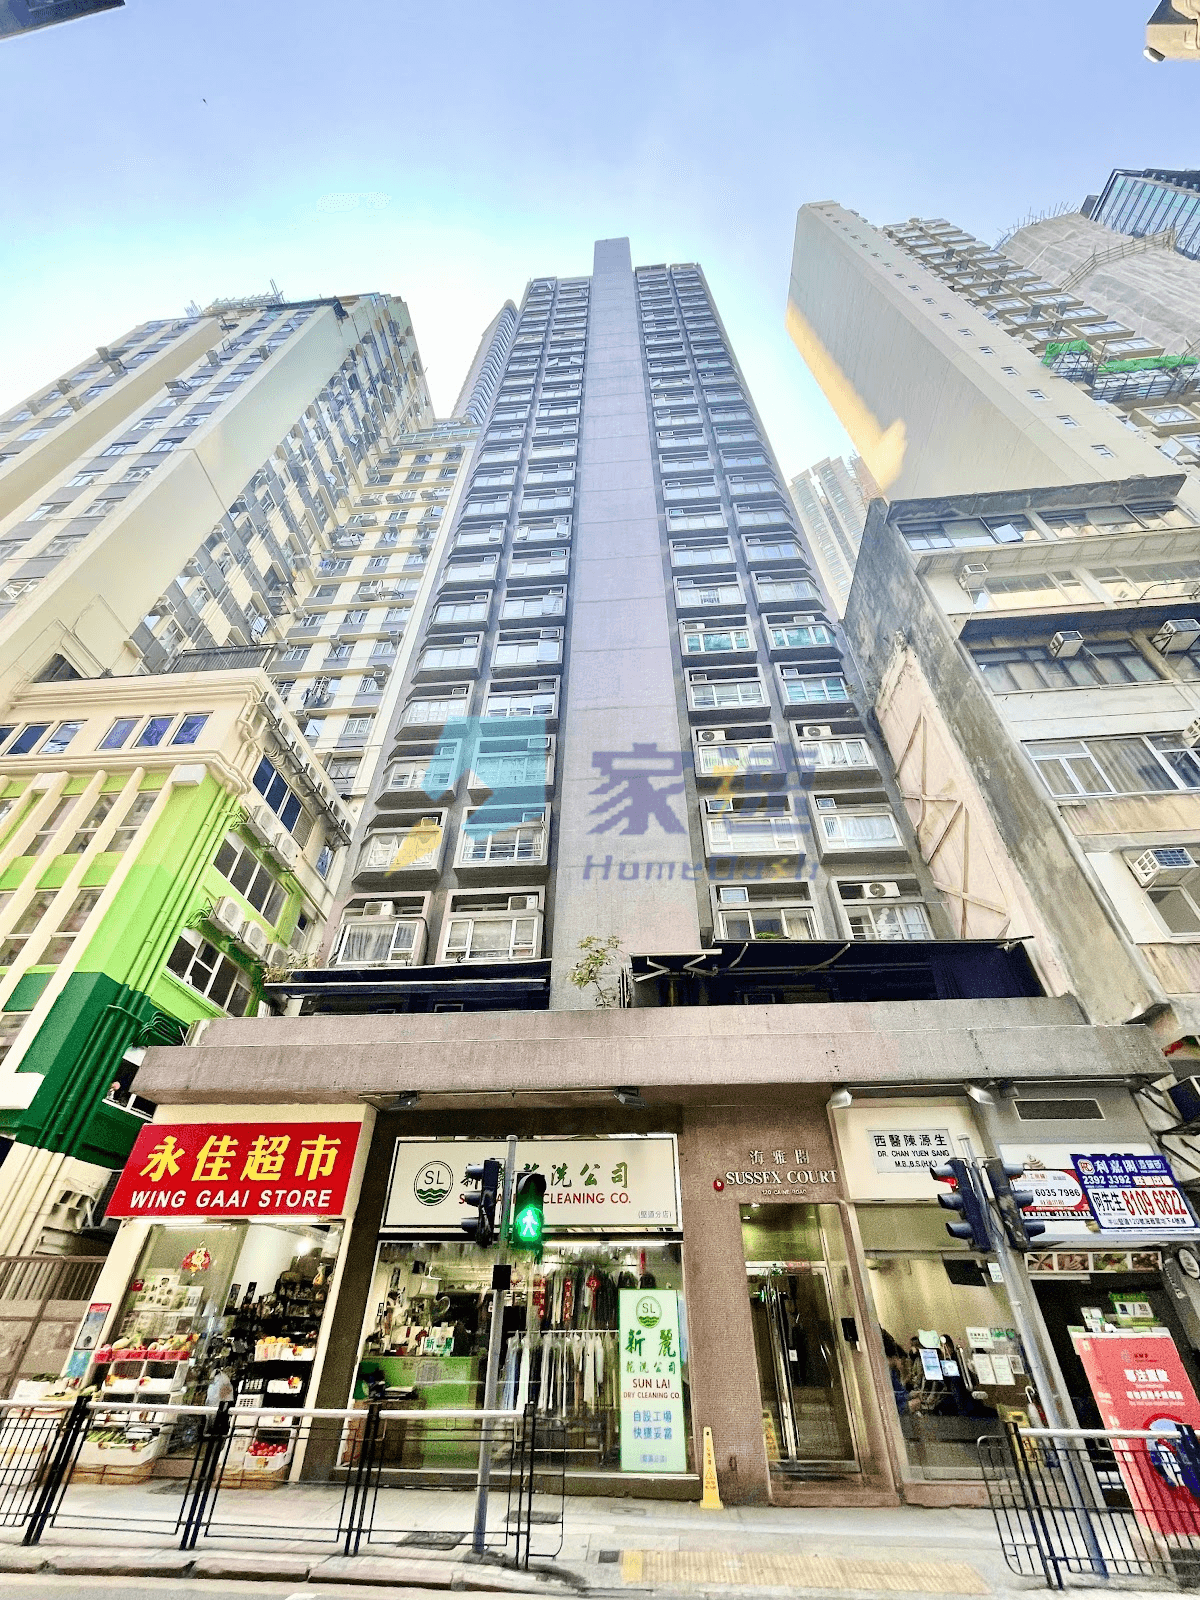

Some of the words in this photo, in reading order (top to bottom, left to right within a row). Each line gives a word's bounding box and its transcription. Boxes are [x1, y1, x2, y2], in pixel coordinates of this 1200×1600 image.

[873, 1134, 948, 1147] 西醫陳源生
[139, 1134, 342, 1182] 永佳超市
[877, 1150, 888, 1158] DR.
[931, 1149, 950, 1157] SANG
[424, 1170, 445, 1185] SL
[726, 1170, 781, 1185] SUSSEX
[787, 1169, 838, 1184] COURT
[1082, 1175, 1106, 1185] 2392
[1108, 1175, 1132, 1185] 3392
[130, 1190, 187, 1208] WING
[195, 1189, 250, 1208] GAAI
[258, 1189, 332, 1208] STORE
[542, 1192, 605, 1204] CLEANING
[610, 1192, 632, 1204] CO.
[1034, 1188, 1057, 1197] 6035
[1058, 1188, 1081, 1197] 7986
[1121, 1190, 1155, 1216] 8109
[1152, 1189, 1188, 1216] 6822
[642, 1302, 656, 1314] SL
[632, 1378, 653, 1389] SUN
[655, 1378, 671, 1389] LAI
[623, 1391, 635, 1399] DRY
[637, 1391, 668, 1399] CLEANING
